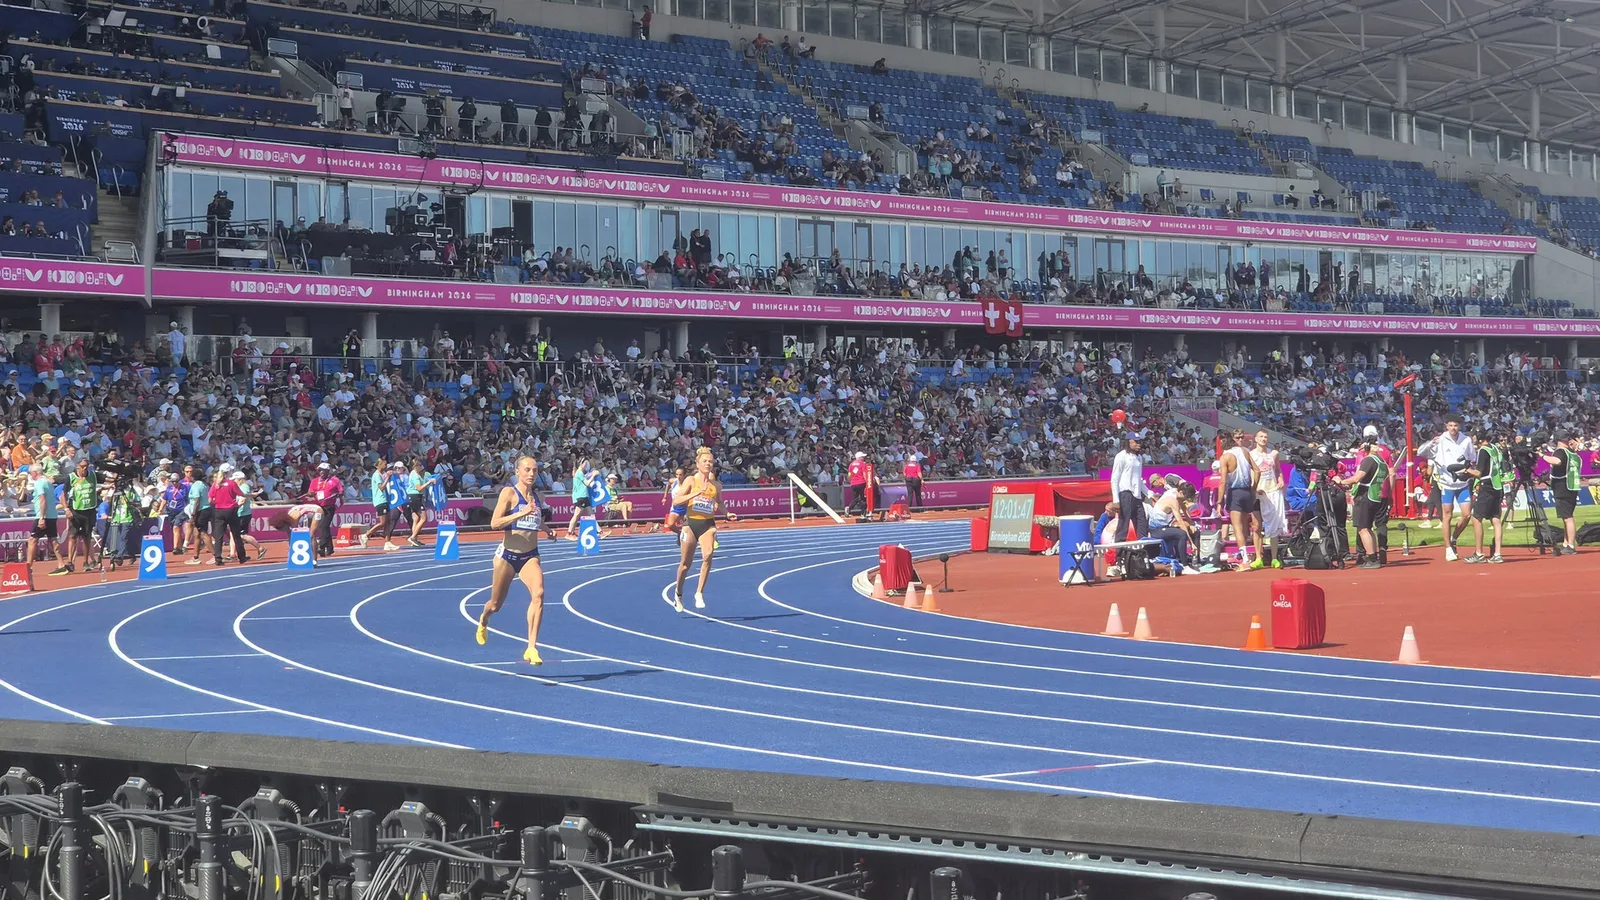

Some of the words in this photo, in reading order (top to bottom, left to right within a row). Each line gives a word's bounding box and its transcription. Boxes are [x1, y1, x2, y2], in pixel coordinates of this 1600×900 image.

[62, 122, 84, 131] 2026
[317, 156, 375, 169] BIRMINGHAM
[379, 162, 402, 171] 2026
[681, 186, 728, 196] BIRMINGHAM
[731, 190, 750, 198] 2026
[889, 202, 931, 211] BIRMINGHAM
[933, 205, 950, 213] 2026
[985, 209, 1024, 218] BIRMINGHAM
[1160, 221, 1196, 229] BIRMINGHAM
[1198, 223, 1213, 231] 2026
[387, 288, 444, 299] BIRMINGHAM
[448, 291, 471, 300] 2026
[752, 302, 800, 311] BIRMINGHAM
[802, 304, 821, 312] 2026
[1056, 312, 1095, 320] BIRMINGHAM
[1097, 313, 1112, 321] 2026
[386, 481, 398, 505] 5
[590, 480, 606, 502] 3
[752, 498, 775, 507] 2026
[994, 499, 1033, 519] 12:01:47
[440, 531, 456, 556] 7
[581, 525, 596, 550] 6
[990, 531, 1018, 544] Birmingham
[291, 539, 310, 566] 8
[1076, 541, 1093, 552] VITA
[143, 545, 162, 573] 9
[1272, 600, 1292, 608] OMEGA
